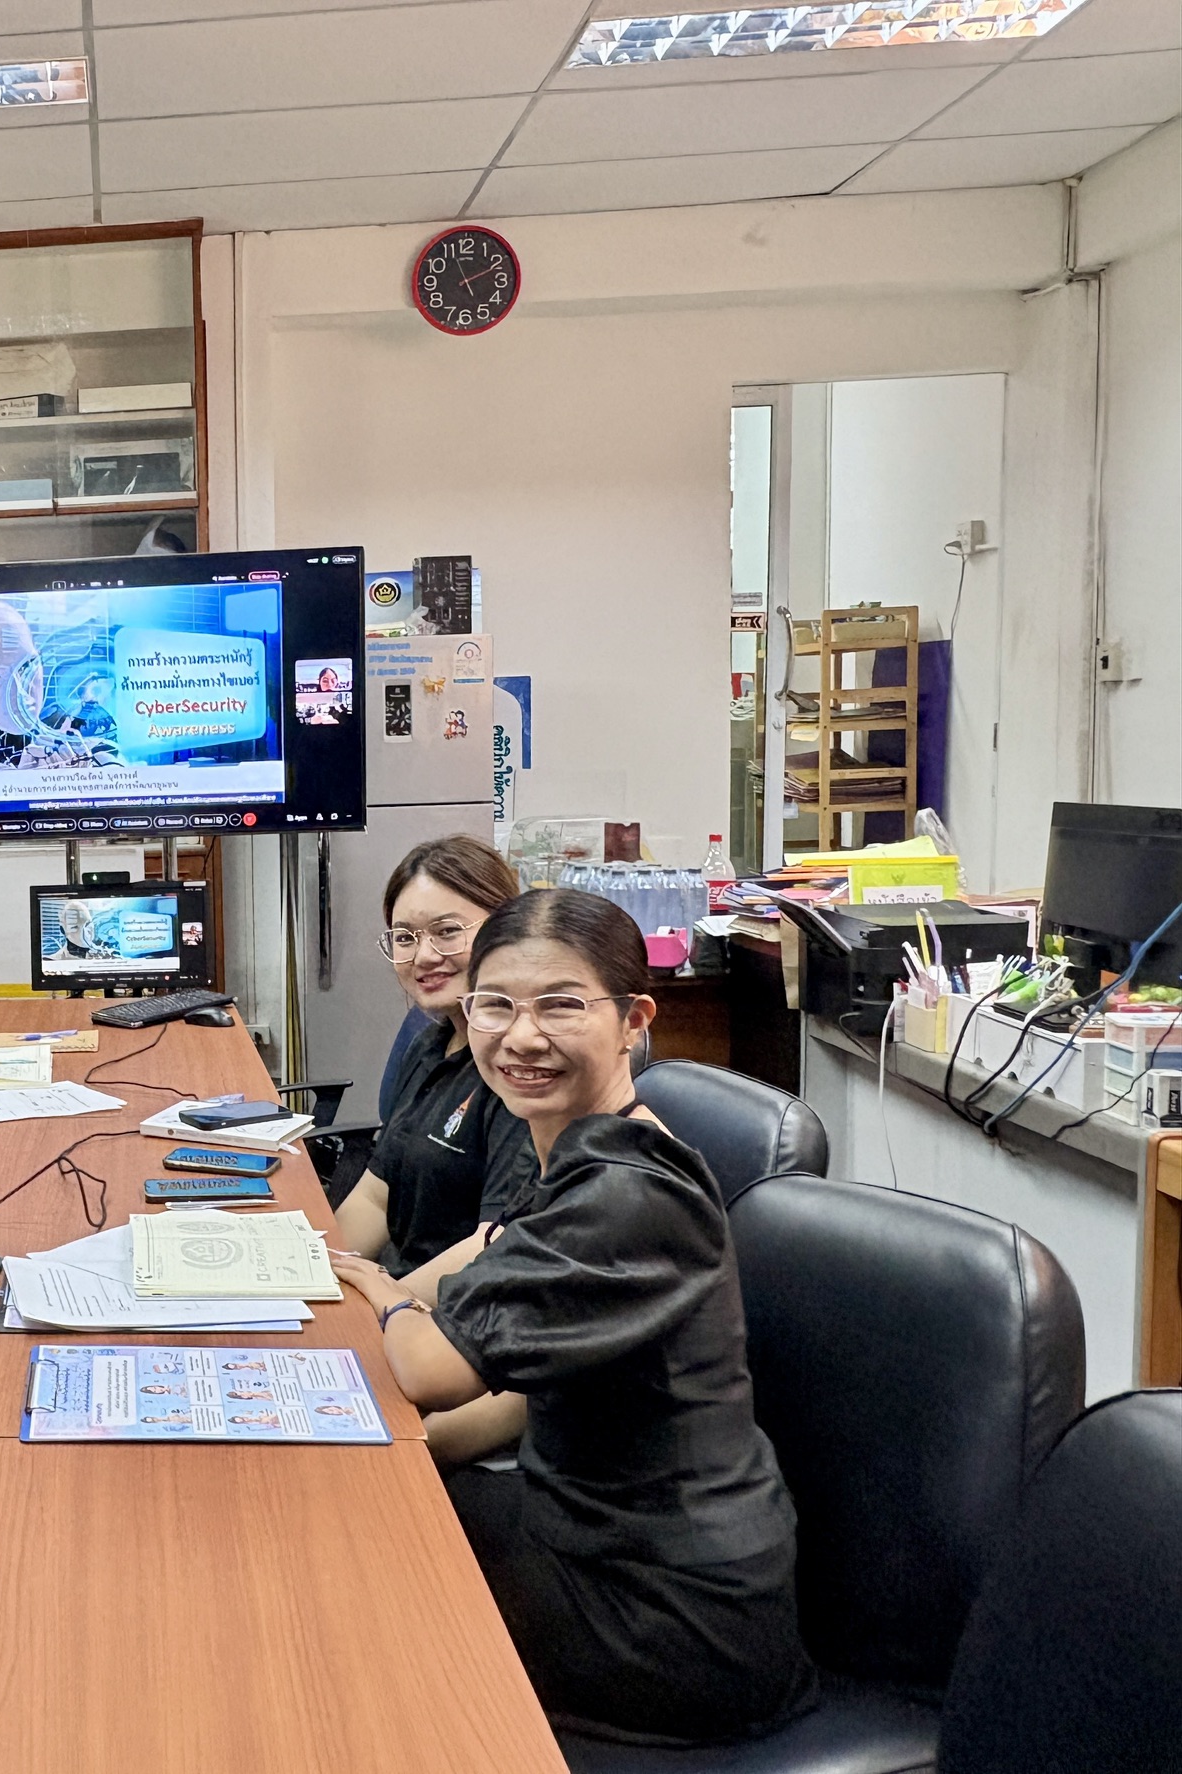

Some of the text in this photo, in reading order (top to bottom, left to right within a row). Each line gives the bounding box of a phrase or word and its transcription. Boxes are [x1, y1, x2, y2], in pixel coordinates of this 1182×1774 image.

[443, 243, 455, 258] 11
[458, 238, 475, 254] 12
[482, 242, 487, 257] 1
[428, 257, 446, 273] 10
[490, 254, 503, 270] 2
[423, 275, 437, 291] 9
[494, 272, 508, 288] 3
[429, 292, 443, 308] 8
[488, 290, 502, 305] 4
[444, 306, 457, 321] 7
[458, 309, 472, 325] 6
[476, 303, 490, 319] 5
[135, 697, 247, 718] CyberSecurity
[148, 722, 236, 738] Awareness
